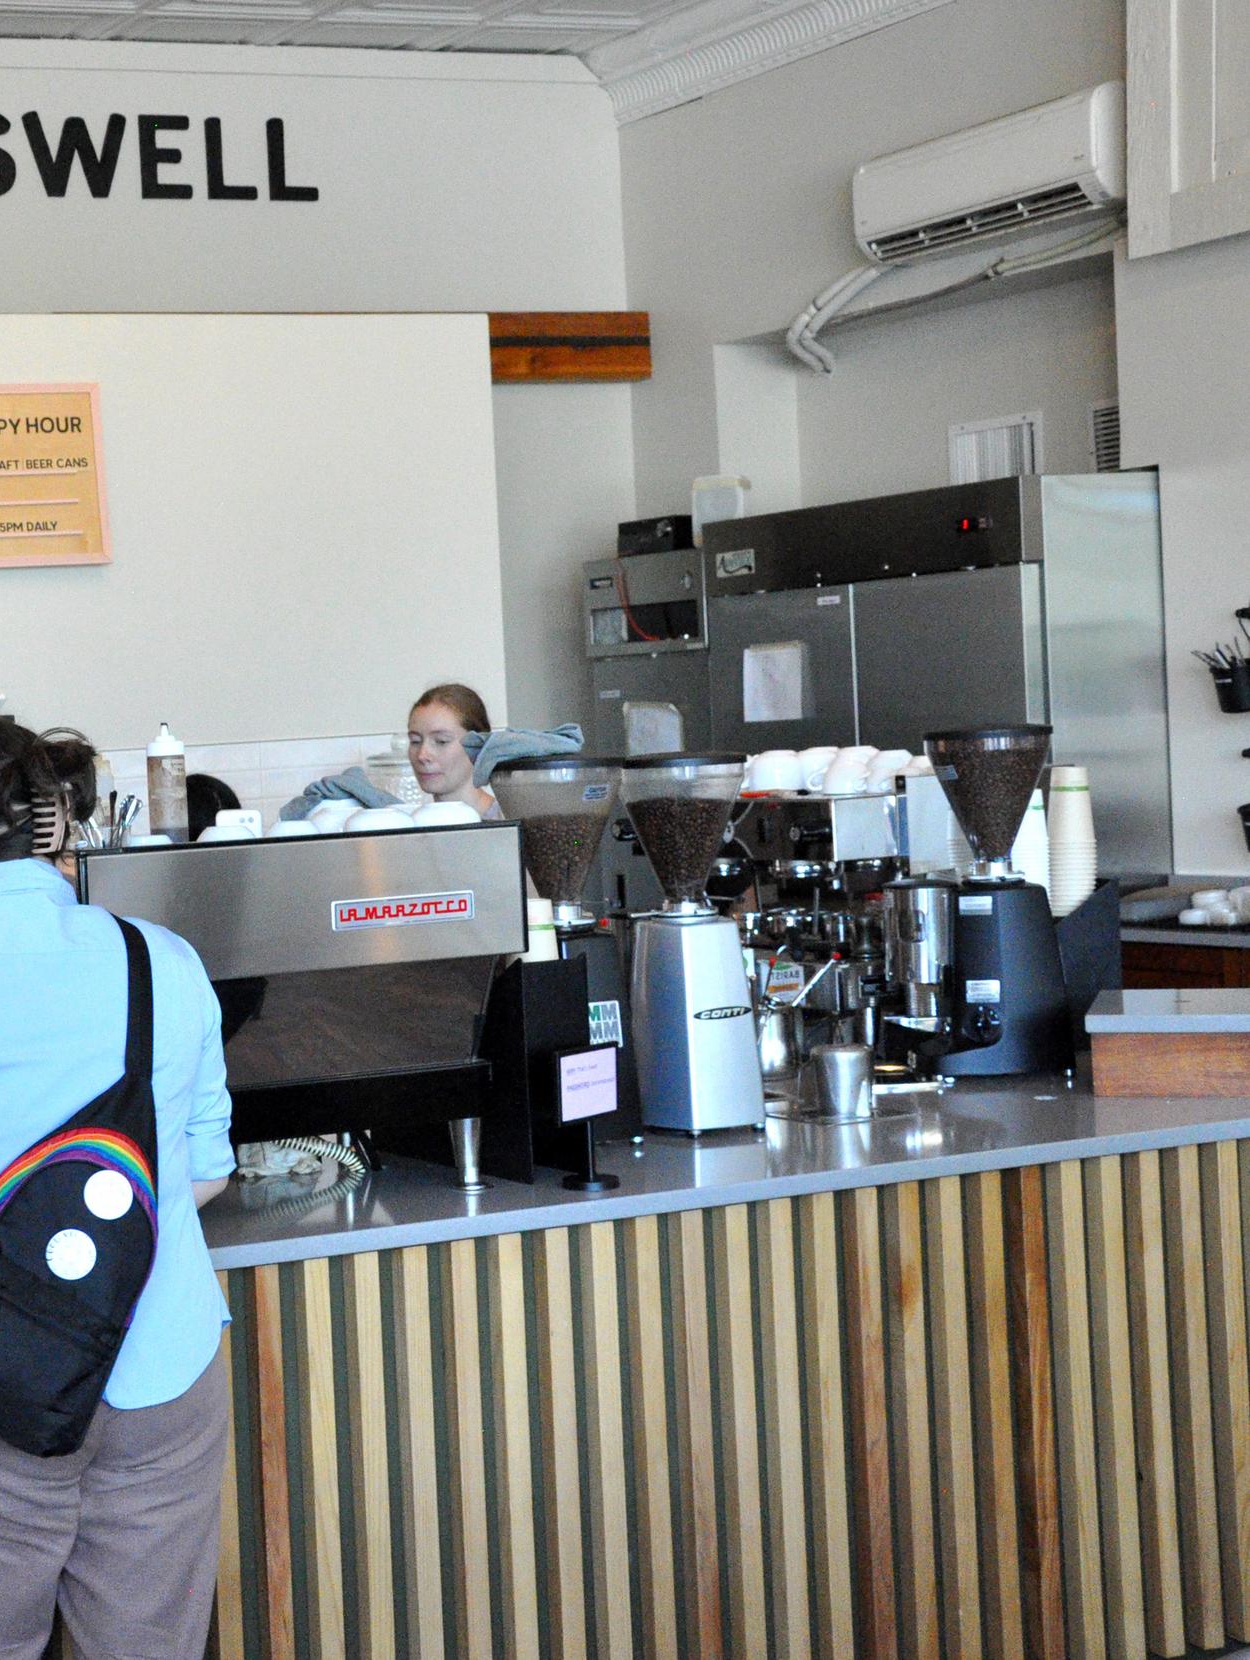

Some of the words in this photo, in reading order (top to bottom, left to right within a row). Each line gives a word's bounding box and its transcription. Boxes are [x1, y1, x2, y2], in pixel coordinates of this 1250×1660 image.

[26, 416, 81, 434] HOUR
[26, 458, 53, 469] BEER
[57, 457, 88, 468] CANS
[26, 521, 58, 532] DAILY
[365, 899, 467, 921] MARZOCCO
[700, 1006, 745, 1019] CONTI
